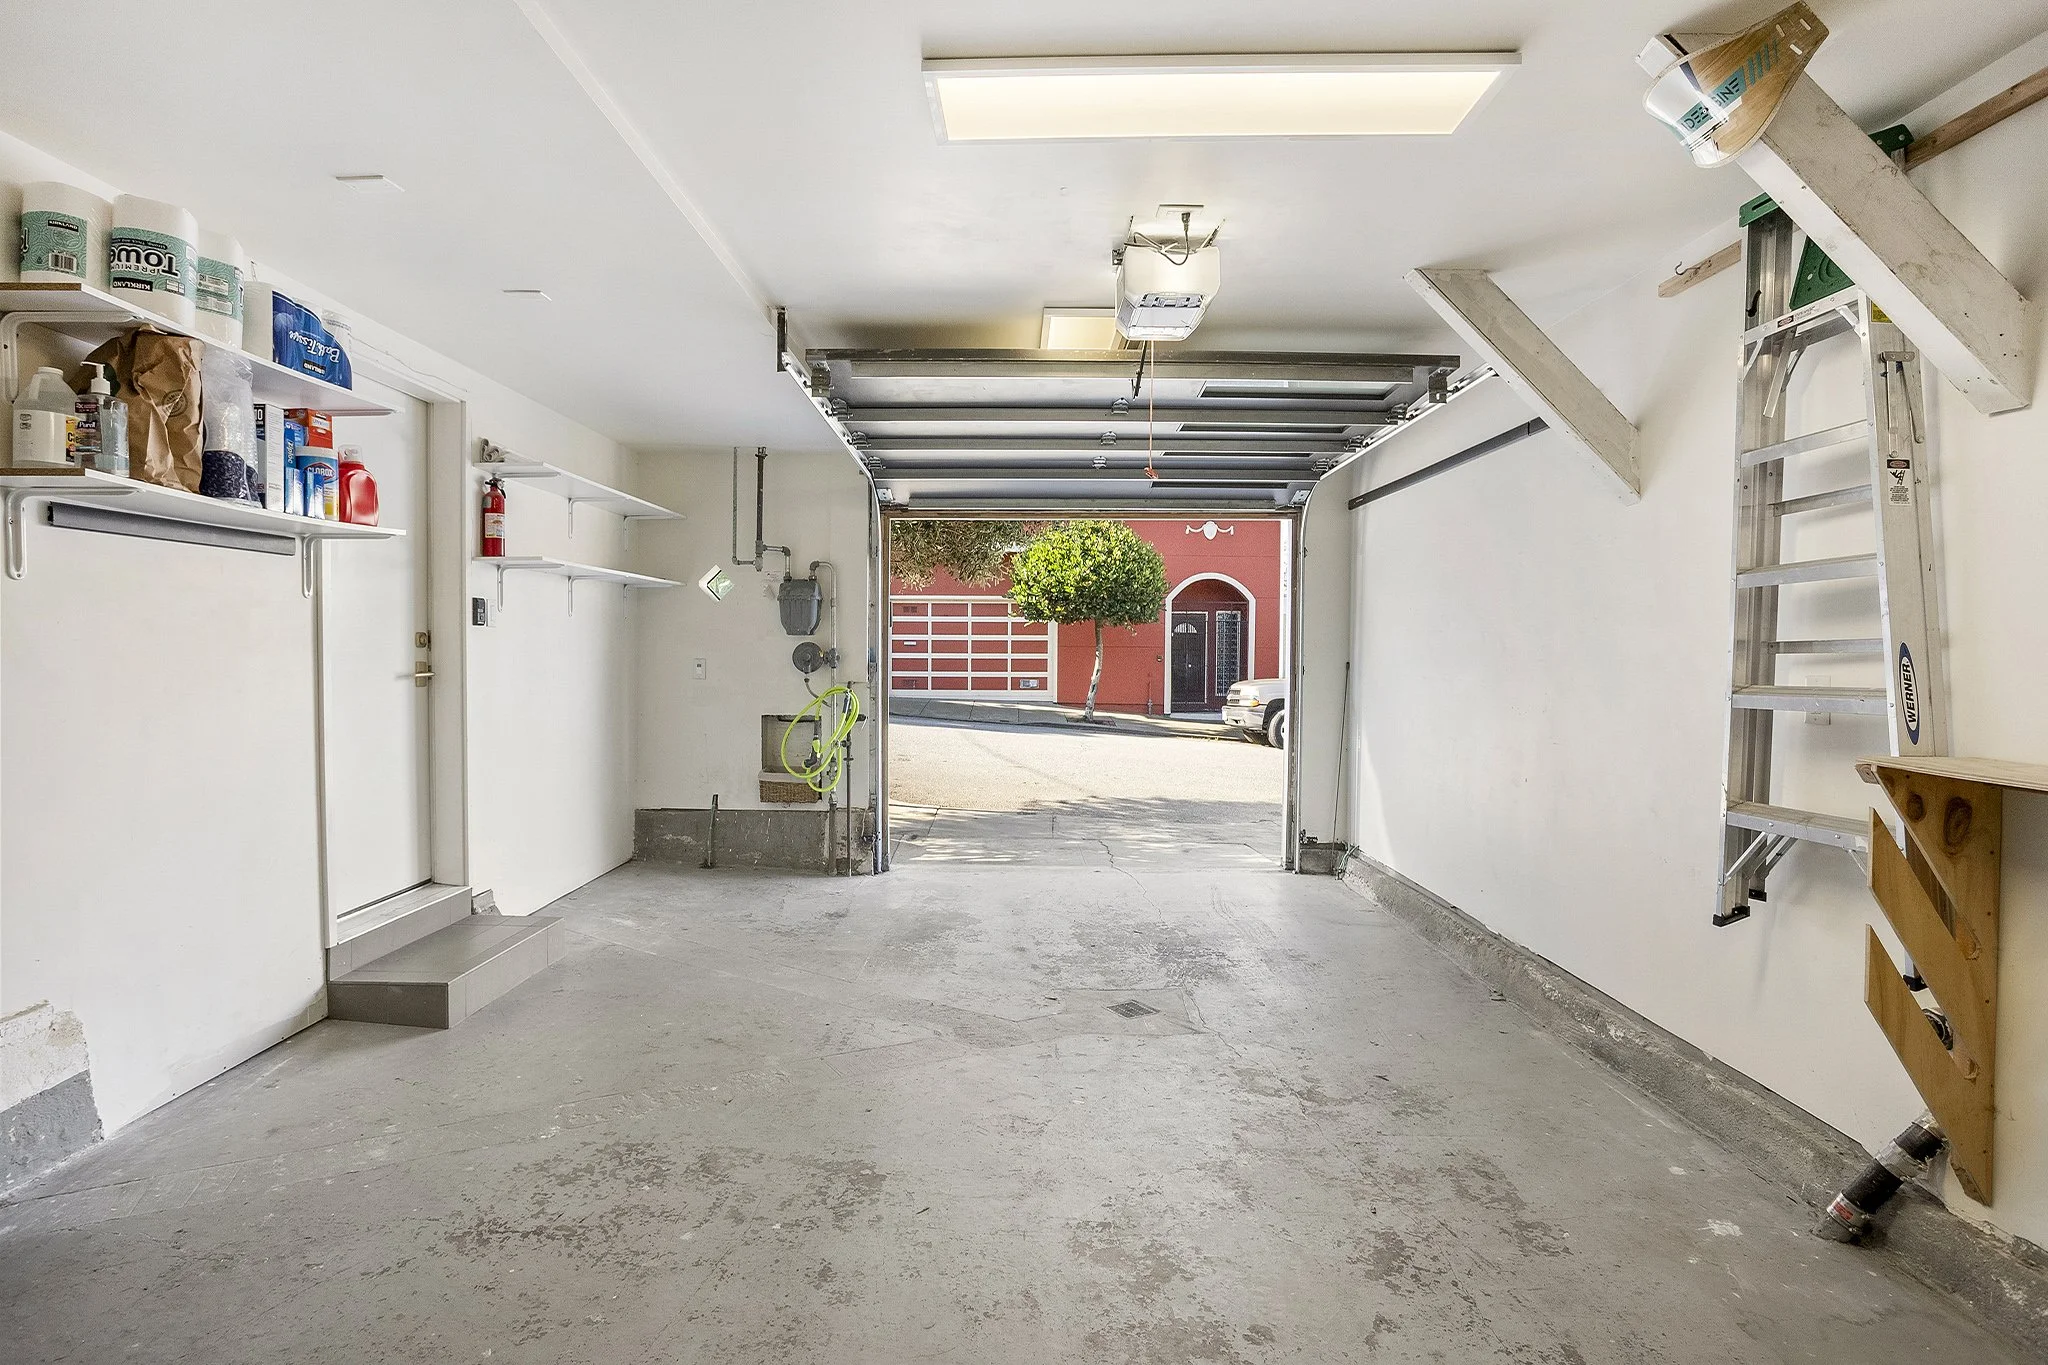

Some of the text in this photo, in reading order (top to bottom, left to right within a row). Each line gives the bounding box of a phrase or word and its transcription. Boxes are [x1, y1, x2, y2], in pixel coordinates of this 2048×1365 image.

[112, 281, 151, 290] KIRKLAND
[288, 330, 317, 355] Tissue
[316, 342, 340, 363] Bath
[1902, 663, 1917, 723] WERNER
